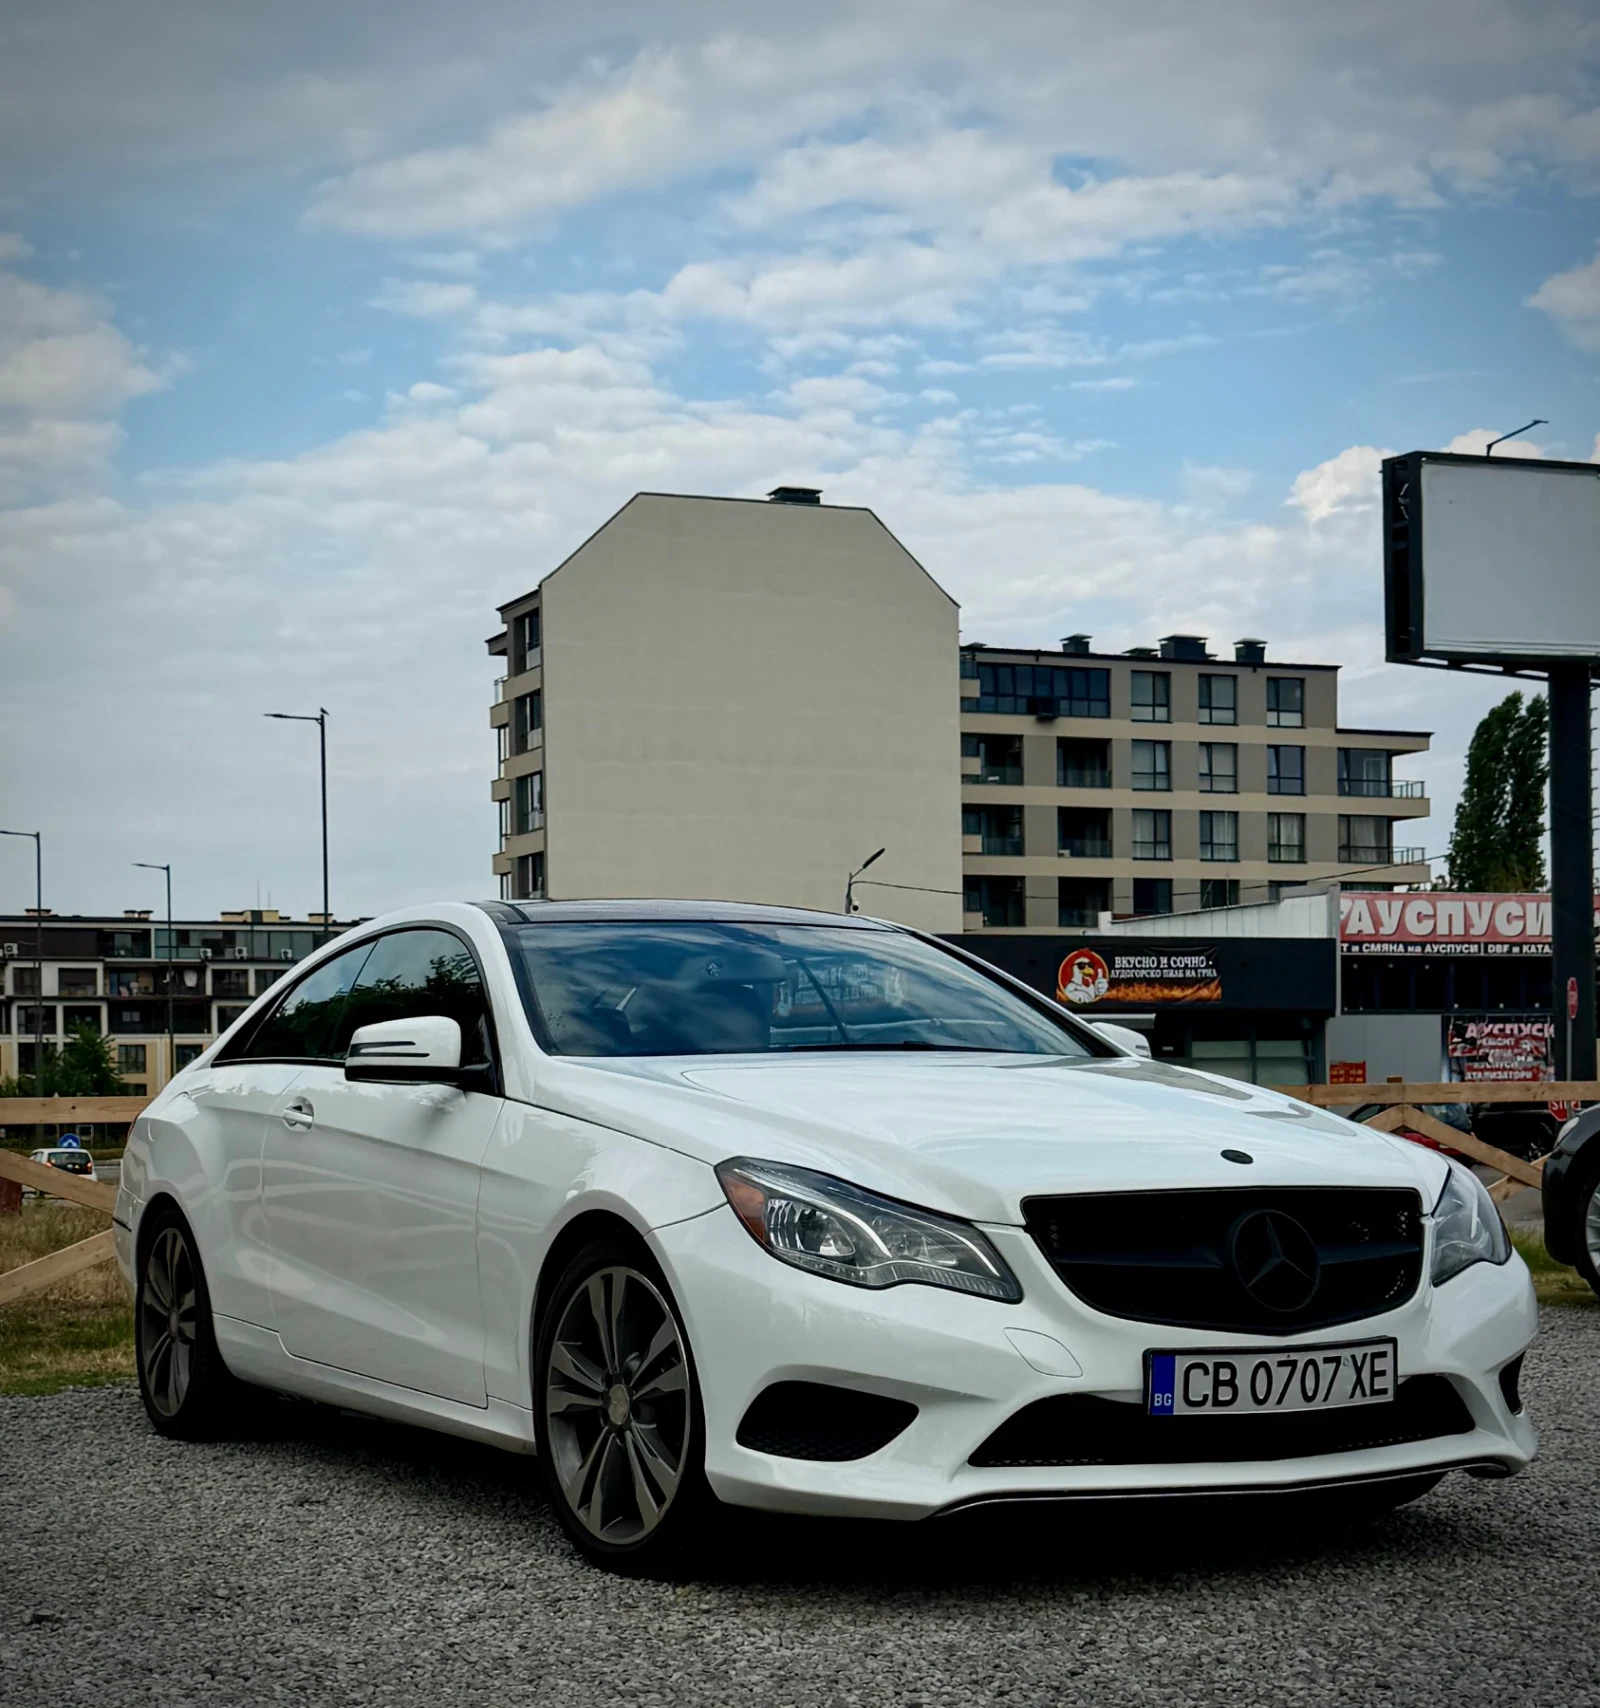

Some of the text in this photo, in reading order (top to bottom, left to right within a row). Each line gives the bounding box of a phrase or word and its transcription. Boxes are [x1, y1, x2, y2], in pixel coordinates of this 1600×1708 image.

[1345, 899, 1552, 938] АУСПУСИ
[1362, 944, 1405, 954] СМЯНА
[1424, 944, 1479, 954] АУСПУСИ
[1114, 956, 1206, 968] ВКУСНО И СОЧНО
[1110, 968, 1162, 979] ЛУДОГОРСКО
[1185, 969, 1196, 978] НА
[1183, 1350, 1389, 1408] CB 0707 XE
[1153, 1393, 1172, 1407] BG
